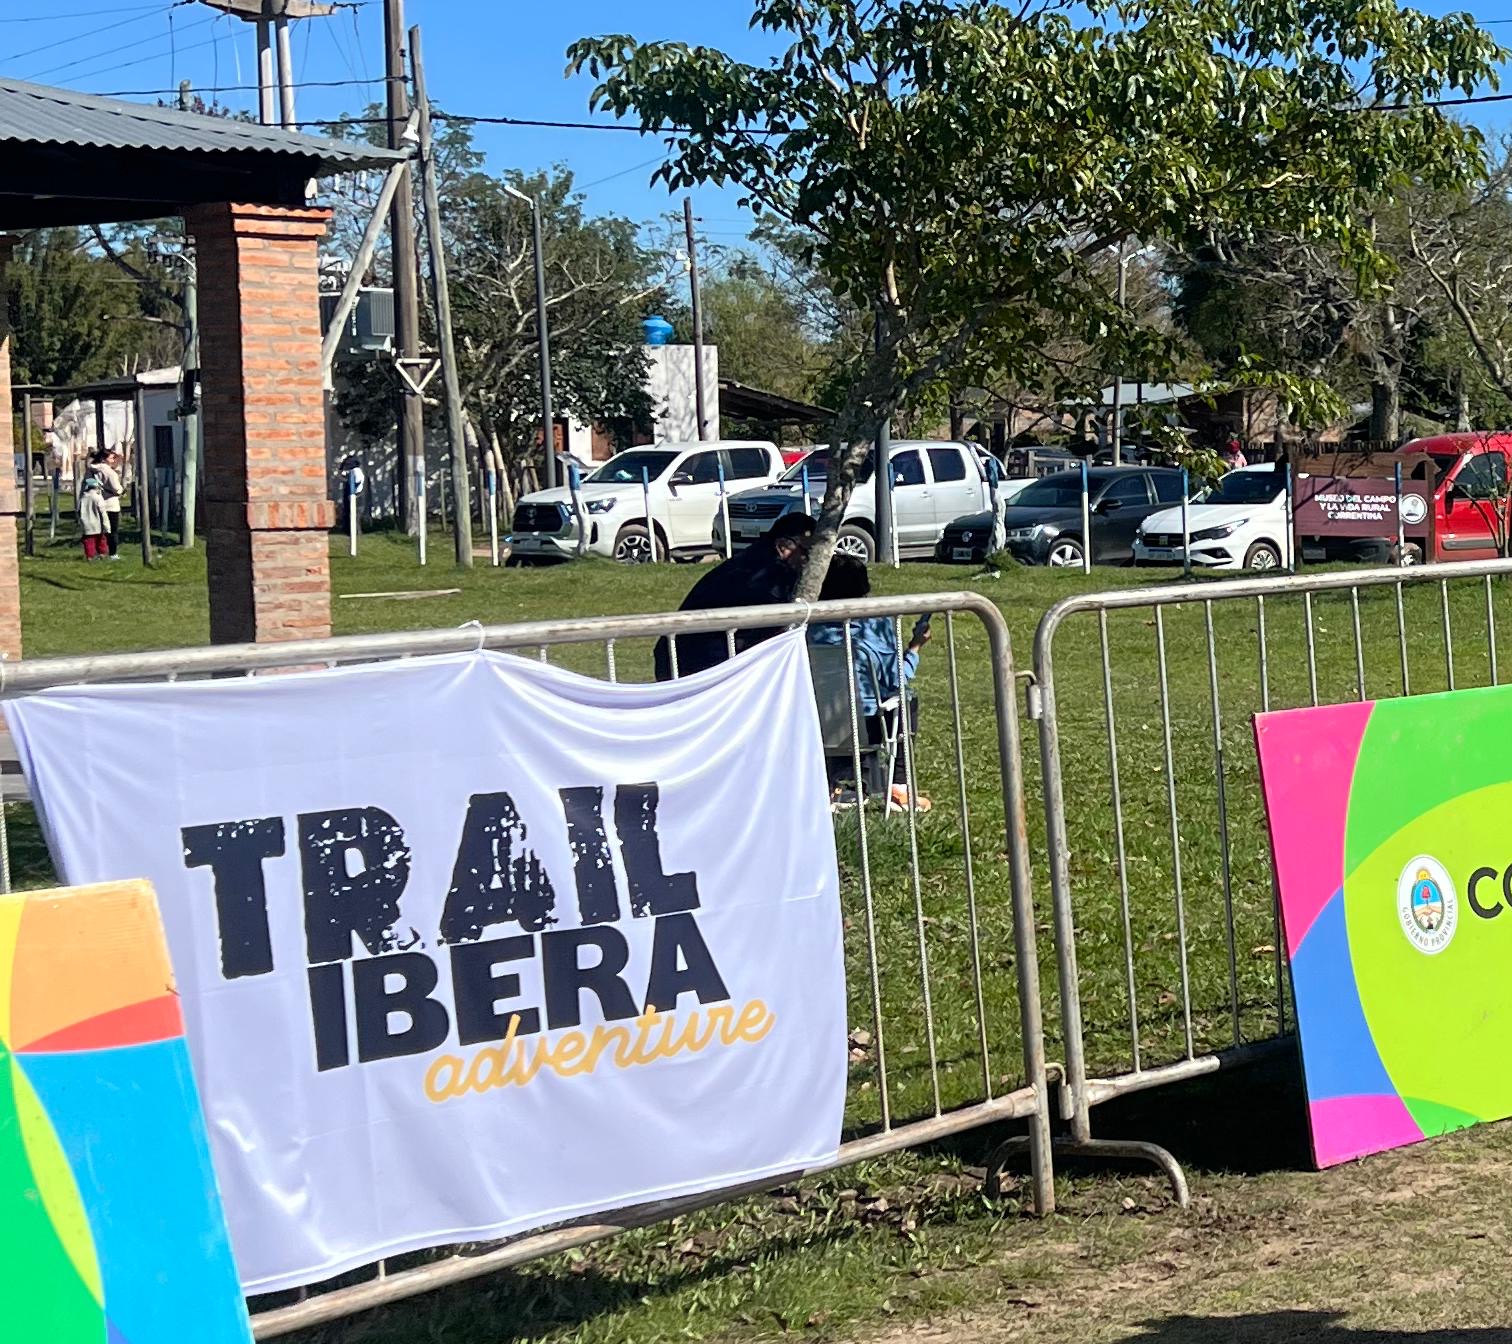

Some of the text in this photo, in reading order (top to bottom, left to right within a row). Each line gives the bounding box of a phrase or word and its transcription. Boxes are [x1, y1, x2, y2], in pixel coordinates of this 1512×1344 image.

[1327, 502, 1339, 511] LA
[1361, 503, 1391, 512] RURAL
[1345, 494, 1363, 503] DEL
[1363, 494, 1397, 503] CAMPO
[181, 781, 701, 980] TRAIL
[1402, 898, 1454, 947] GOBIERNO PROVINCIAL
[307, 912, 731, 1072] IBERA
[423, 998, 776, 1103] adventure
